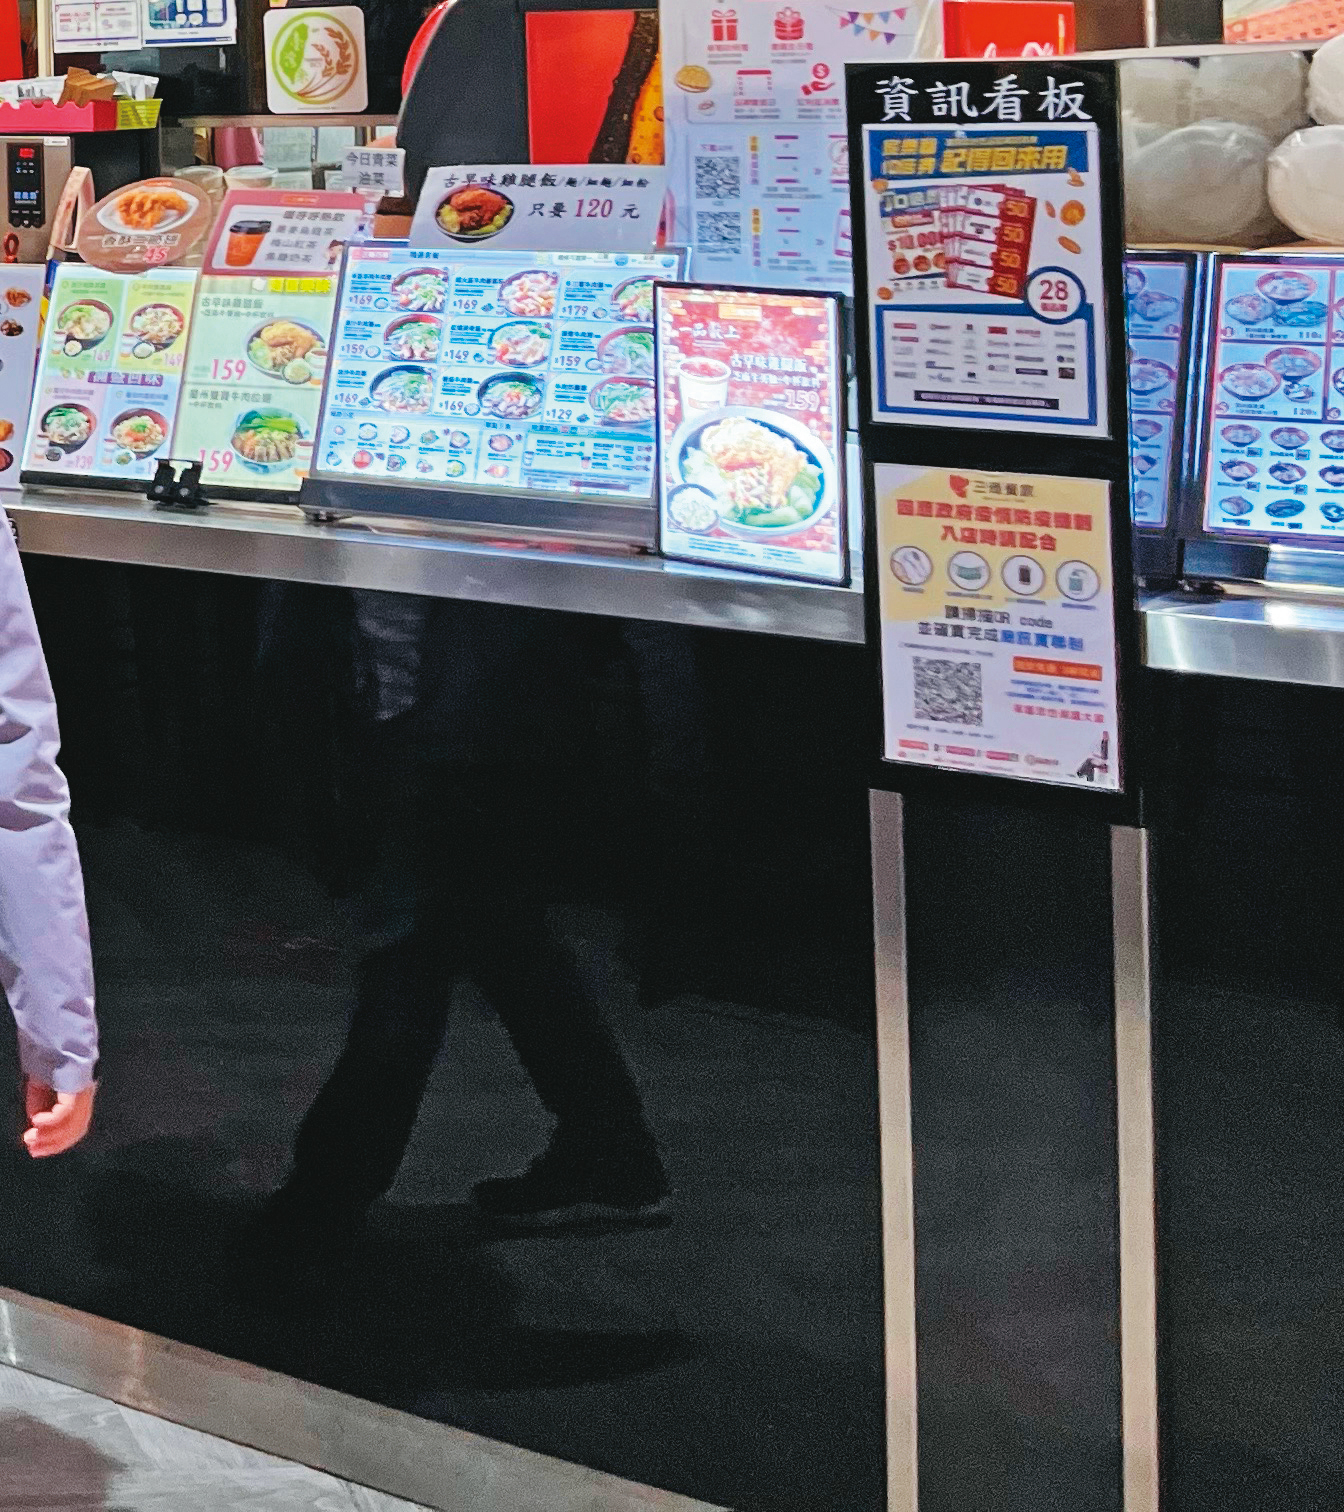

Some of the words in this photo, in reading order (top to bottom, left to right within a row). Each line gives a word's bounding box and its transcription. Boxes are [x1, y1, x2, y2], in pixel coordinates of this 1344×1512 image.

[875, 74, 1092, 123] 資訊看板
[528, 202, 568, 218] 只要
[574, 198, 614, 218] 120
[619, 203, 641, 219] 元
[1039, 279, 1070, 301] 28
[212, 358, 247, 382] 159
[784, 389, 821, 412] 159
[199, 448, 234, 473] 159
